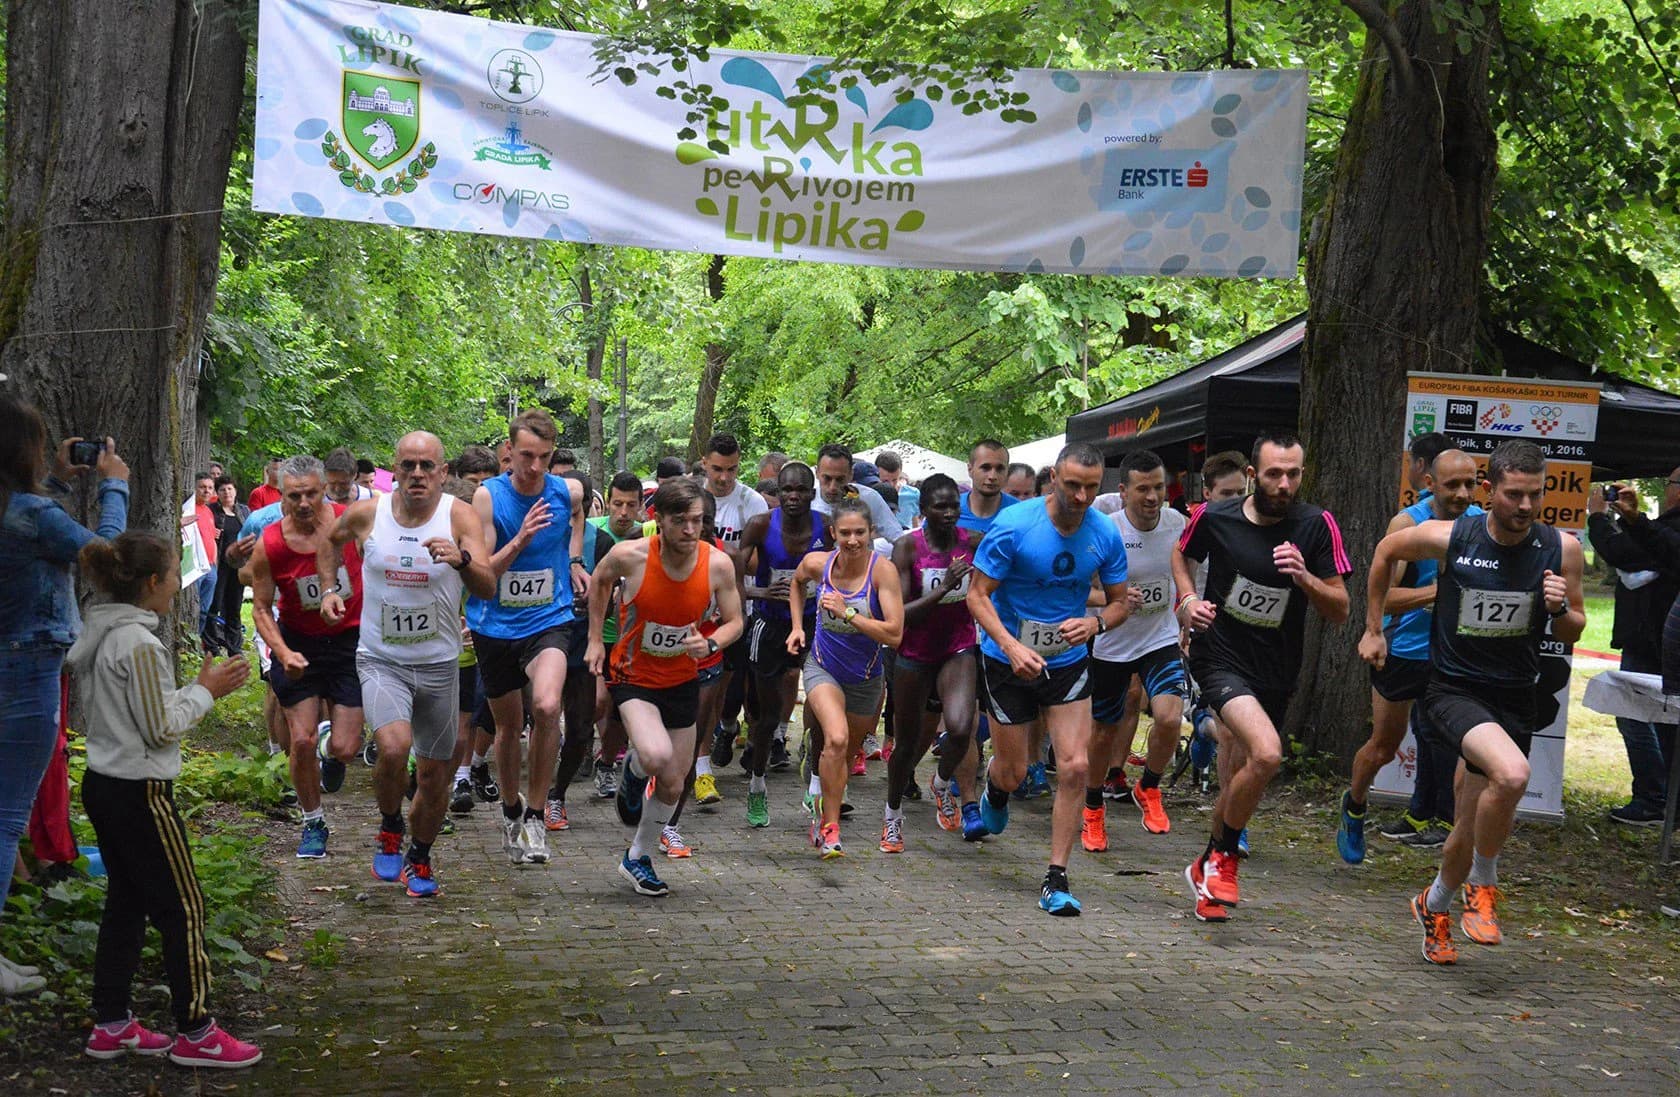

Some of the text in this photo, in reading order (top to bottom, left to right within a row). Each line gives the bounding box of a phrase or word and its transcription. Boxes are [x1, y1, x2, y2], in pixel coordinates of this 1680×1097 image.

[350, 26, 413, 48] GRAD
[336, 45, 426, 77] LIPIK
[479, 101, 525, 114] TOPLICE
[1104, 133, 1163, 144] powered by:
[1120, 168, 1184, 188] ERSTE
[453, 183, 570, 210] COMPAS
[1118, 189, 1145, 200] Bank
[725, 195, 889, 253] Lipika
[1419, 381, 1461, 391] EUROPSKI
[1462, 384, 1481, 393] FIBA
[1557, 390, 1589, 400] TURNIR
[1450, 403, 1473, 415] FIBA
[1490, 423, 1525, 433] HKS
[1485, 439, 1495, 449] 8.
[1556, 444, 1586, 456] 2016.
[1456, 556, 1500, 569] AK OKIĆ
[509, 578, 546, 596] 047
[1238, 590, 1281, 614] 027
[1472, 602, 1521, 622] 127
[392, 614, 430, 632] 112
